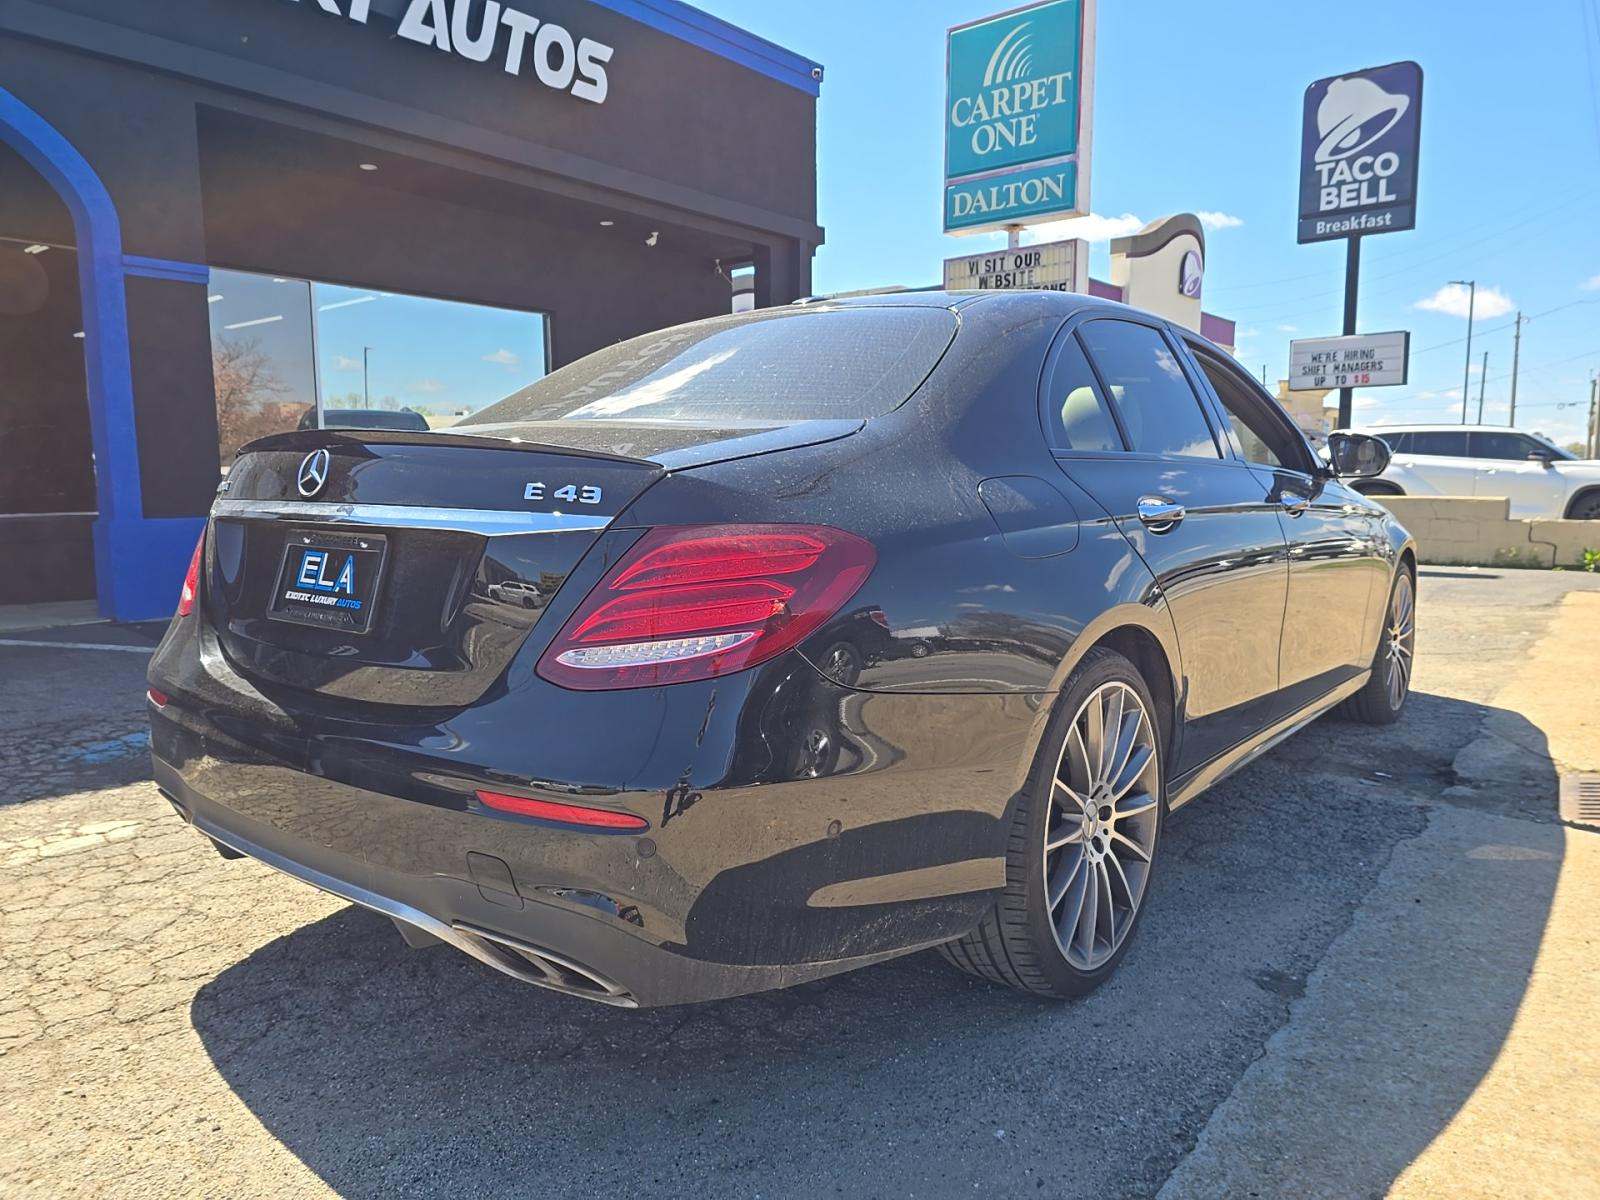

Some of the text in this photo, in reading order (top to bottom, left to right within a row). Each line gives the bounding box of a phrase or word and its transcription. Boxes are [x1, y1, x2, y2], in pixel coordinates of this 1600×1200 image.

[397, 0, 614, 104] AUTOS
[952, 72, 1072, 127] CARPET
[971, 114, 1037, 155] ONE
[1315, 152, 1400, 187] TACO
[953, 173, 1065, 217] DALTON
[1319, 178, 1397, 211] BELL
[1316, 212, 1392, 235] Breakfast
[1014, 252, 1041, 269] OUR
[978, 269, 1034, 290] WEBSITE
[1311, 348, 1375, 363] WE'RE HIRING
[1302, 360, 1384, 376] SHIFT MANAGERS
[1314, 376, 1326, 387] UP
[1335, 374, 1347, 385] TO
[523, 482, 602, 504] E 43
[296, 549, 354, 595] ELA
[285, 590, 363, 610] EXOTIC LUXURY AUTOS
